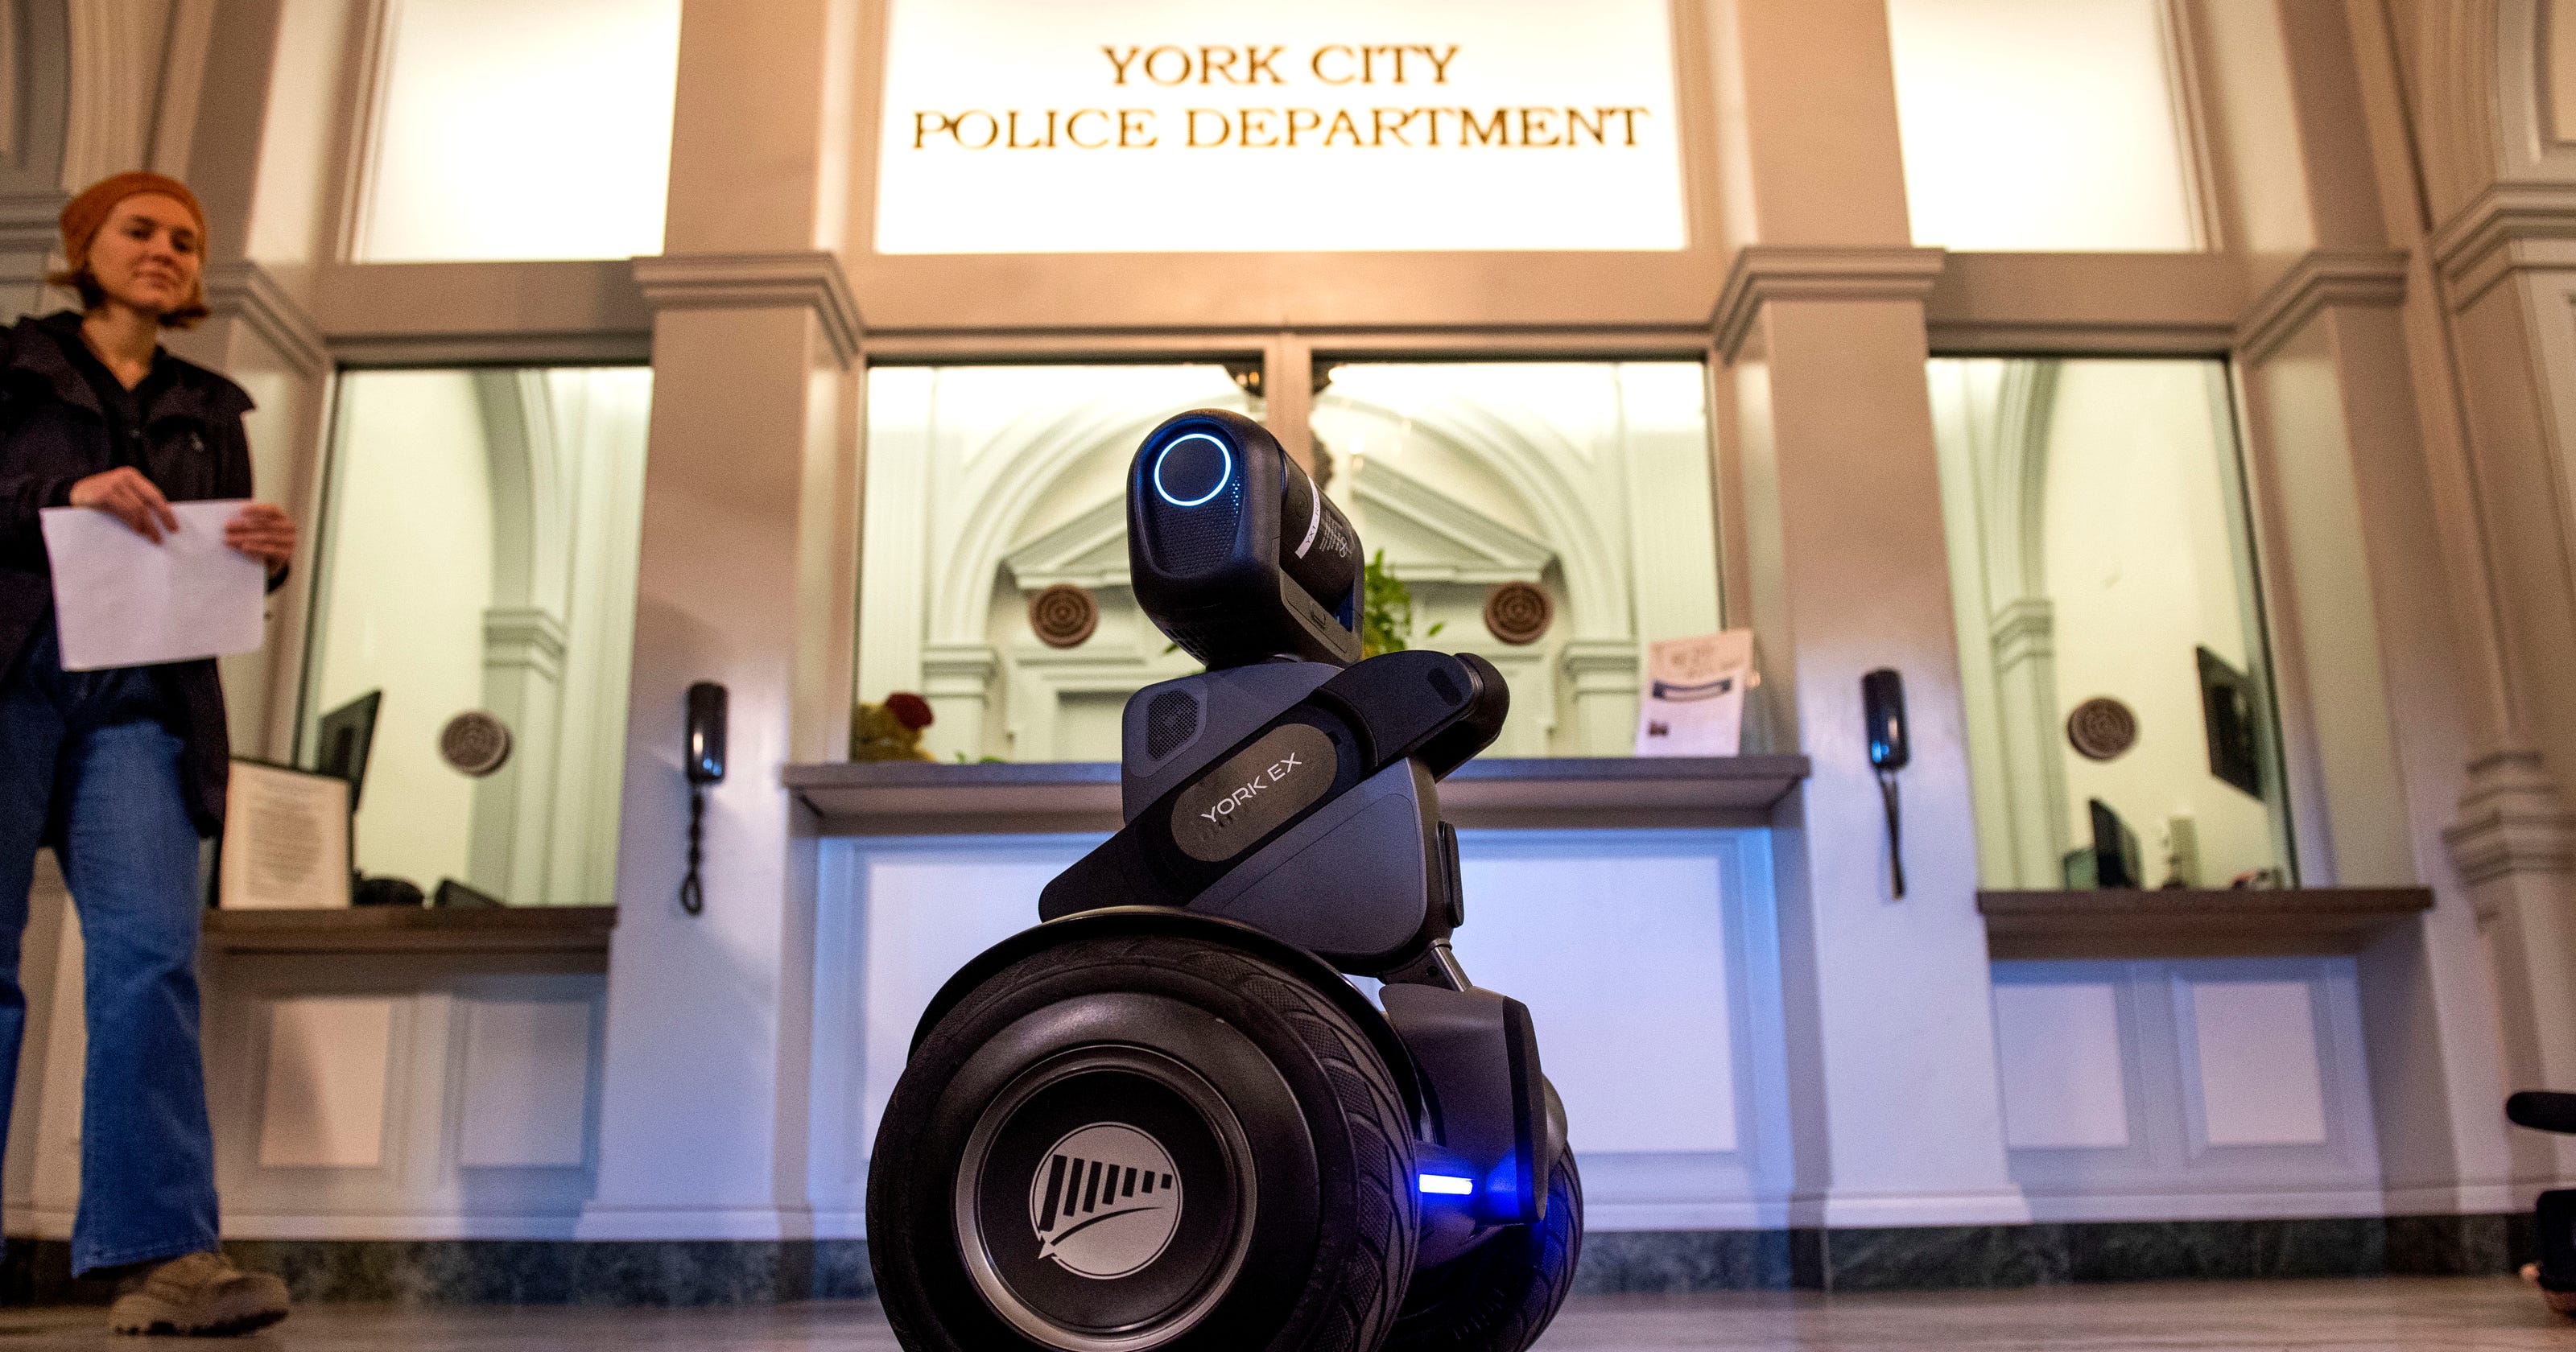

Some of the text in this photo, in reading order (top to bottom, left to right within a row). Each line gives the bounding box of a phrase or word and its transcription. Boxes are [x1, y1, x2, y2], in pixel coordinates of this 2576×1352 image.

[1100, 43, 1460, 84] YORK CITY
[913, 108, 1650, 149] POLICE DEPARTMENT
[1200, 752, 1302, 822] YORK EX
